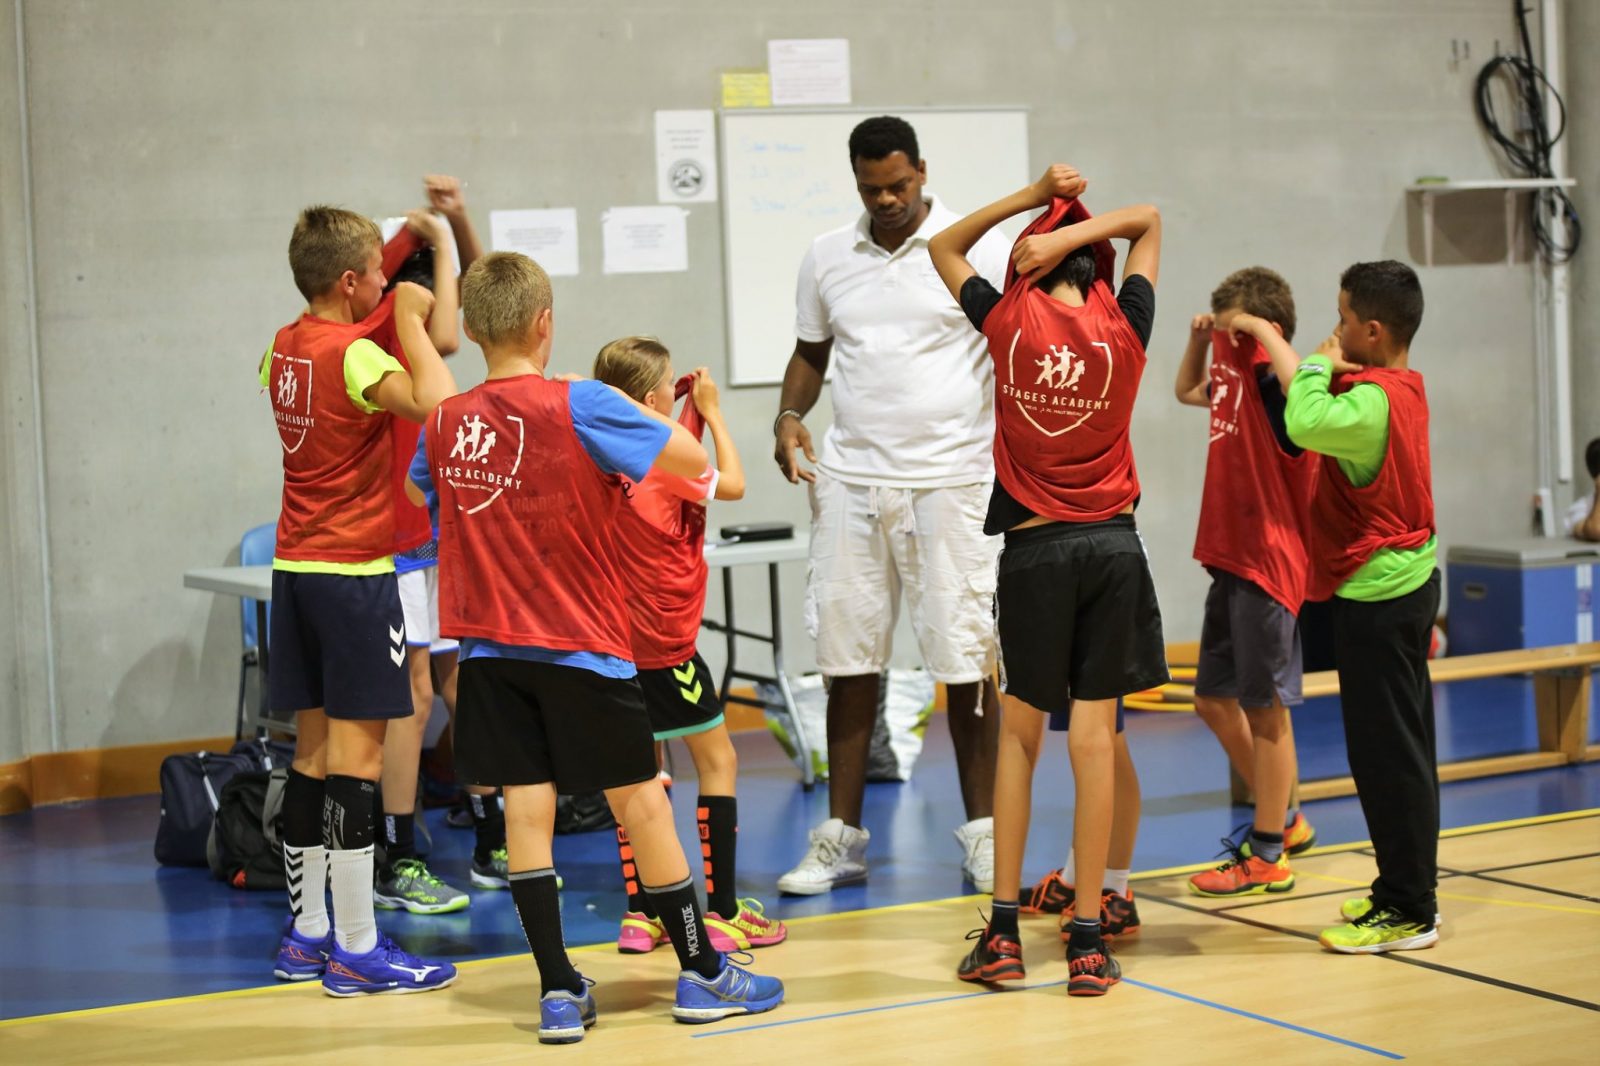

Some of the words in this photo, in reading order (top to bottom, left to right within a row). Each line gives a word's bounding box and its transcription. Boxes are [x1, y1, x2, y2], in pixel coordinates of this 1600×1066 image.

[1002, 384, 1047, 403] STAGES
[1052, 396, 1111, 410] ACADEMY
[681, 903, 699, 957] MCKENZIE
